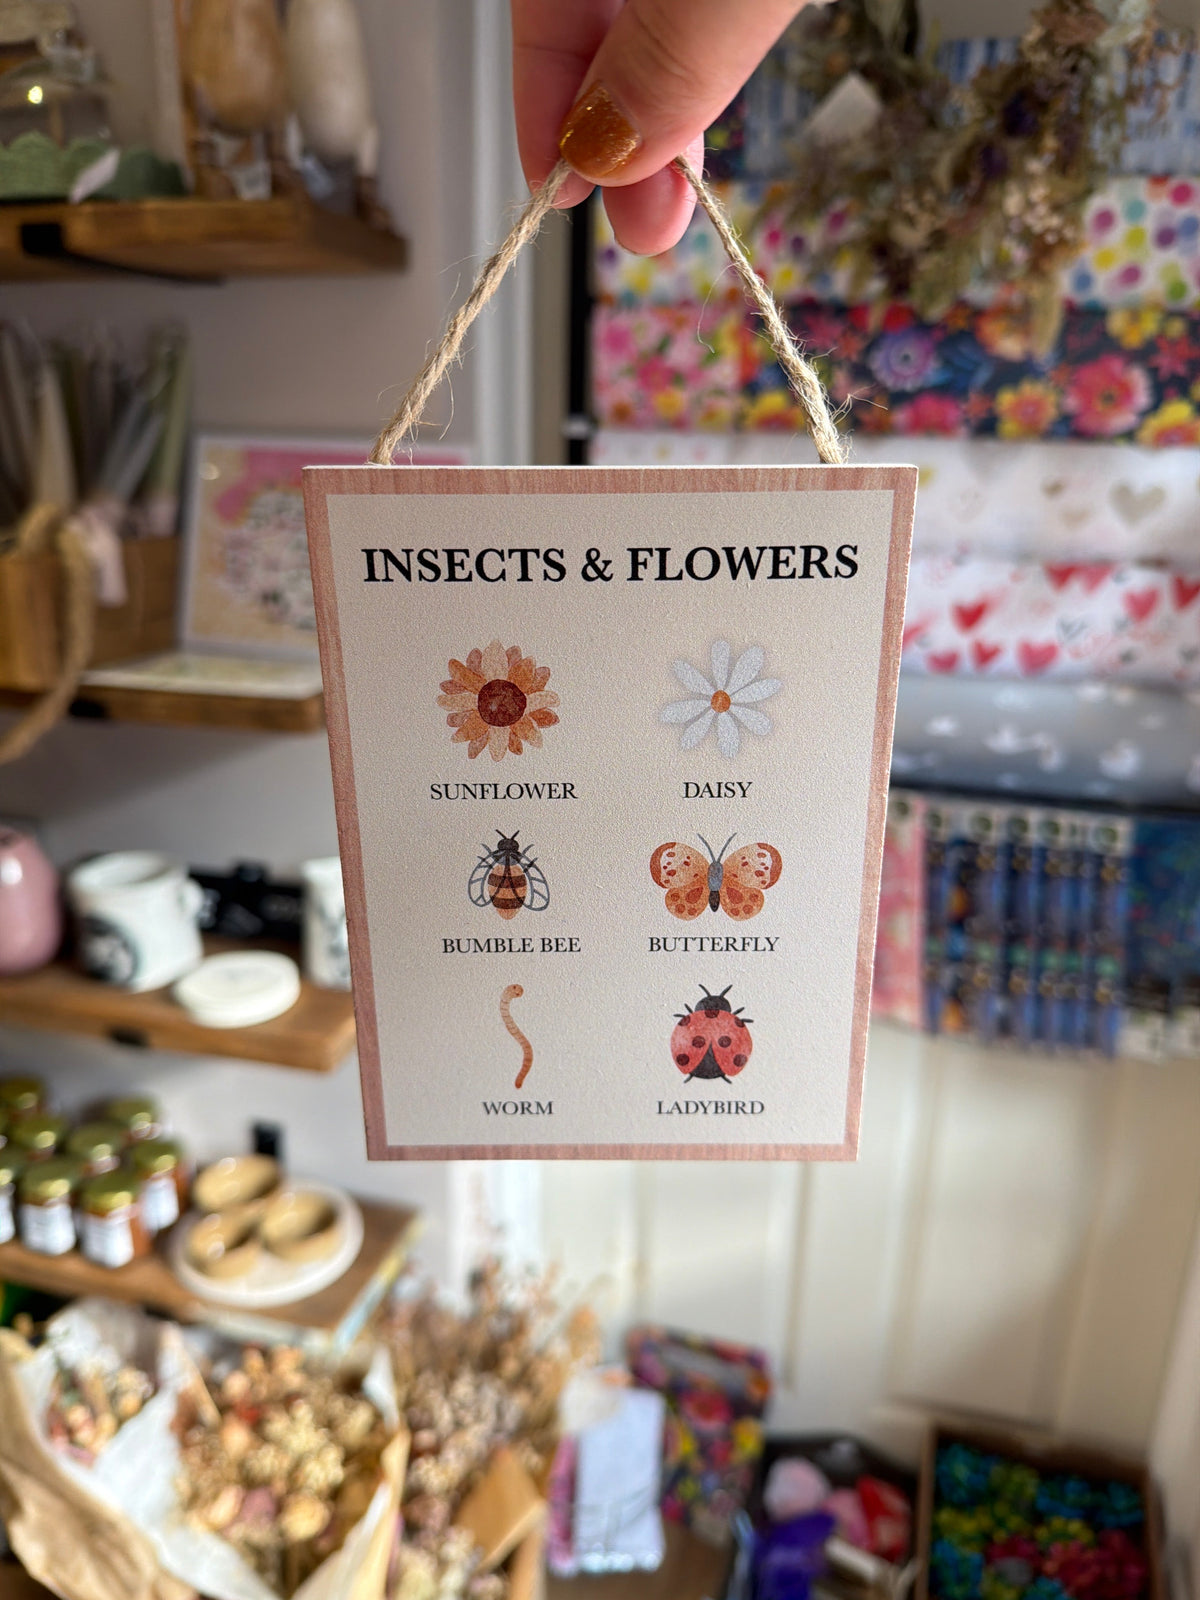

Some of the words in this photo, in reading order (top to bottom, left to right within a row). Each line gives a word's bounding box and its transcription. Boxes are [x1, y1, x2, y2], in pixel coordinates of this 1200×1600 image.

[360, 547, 567, 583] INSECTS
[580, 547, 614, 583] &
[626, 543, 859, 582] FLOWERS
[430, 782, 579, 801] SUNFLOWER
[681, 781, 753, 799] DAISY
[441, 937, 535, 954] BUMBLE
[539, 937, 582, 953] BEE
[648, 936, 780, 953] BUTTERFLY
[482, 1101, 553, 1116] WORM
[657, 1100, 765, 1115] LADYBIRD
